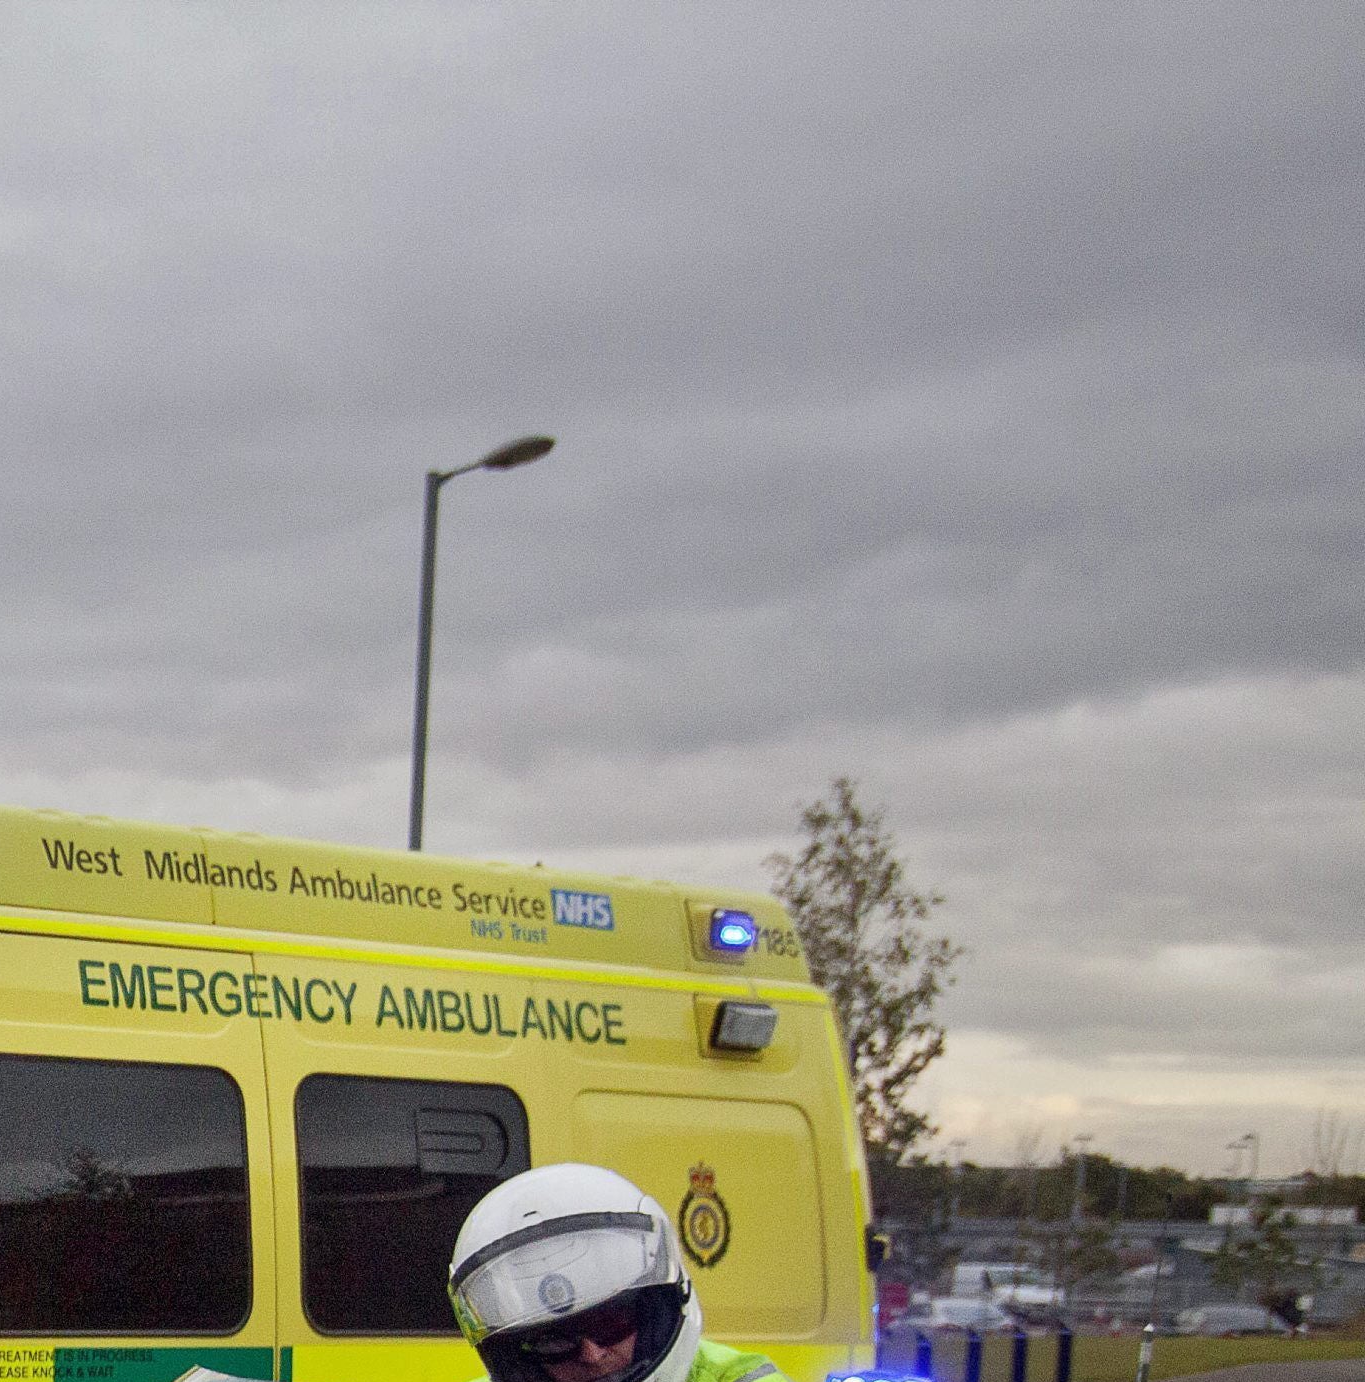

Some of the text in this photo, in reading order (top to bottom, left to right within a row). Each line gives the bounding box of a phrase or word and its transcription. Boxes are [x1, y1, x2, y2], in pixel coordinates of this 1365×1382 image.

[41, 837, 612, 929] West Midlands Ambulance Service NHS
[470, 917, 549, 944] NHS Trust
[78, 959, 627, 1046] EMERGENCY AMBULANCE
[32, 1366, 73, 1378] KNOCK
